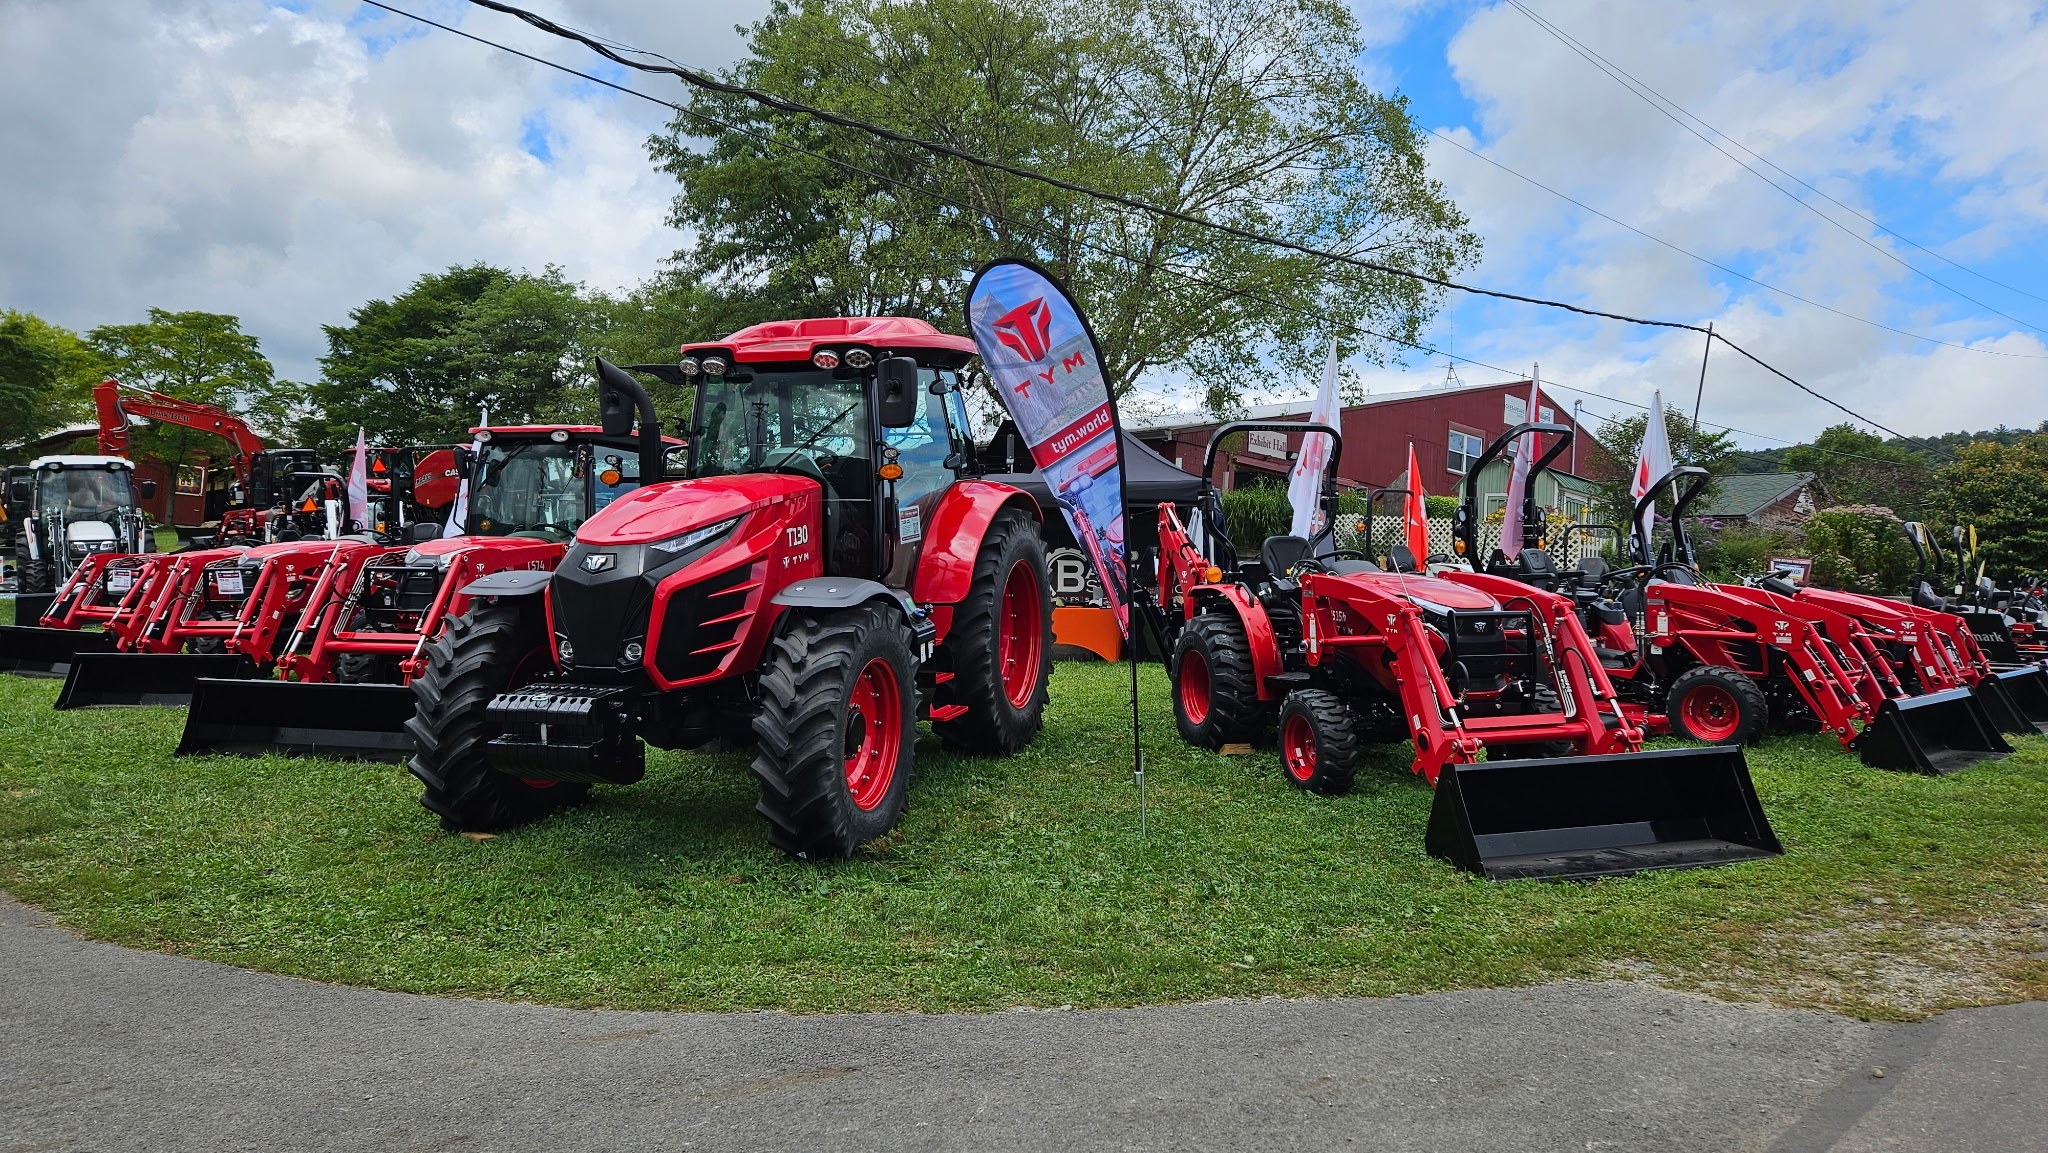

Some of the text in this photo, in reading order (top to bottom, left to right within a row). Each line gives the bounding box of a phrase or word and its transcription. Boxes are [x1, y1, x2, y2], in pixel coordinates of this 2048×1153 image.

[1014, 351, 1085, 398] TYM
[1051, 409, 1110, 453] tym.world
[1249, 433, 1287, 451] Exhibit Hall
[786, 525, 808, 547] T130
[793, 552, 810, 565] TYM
